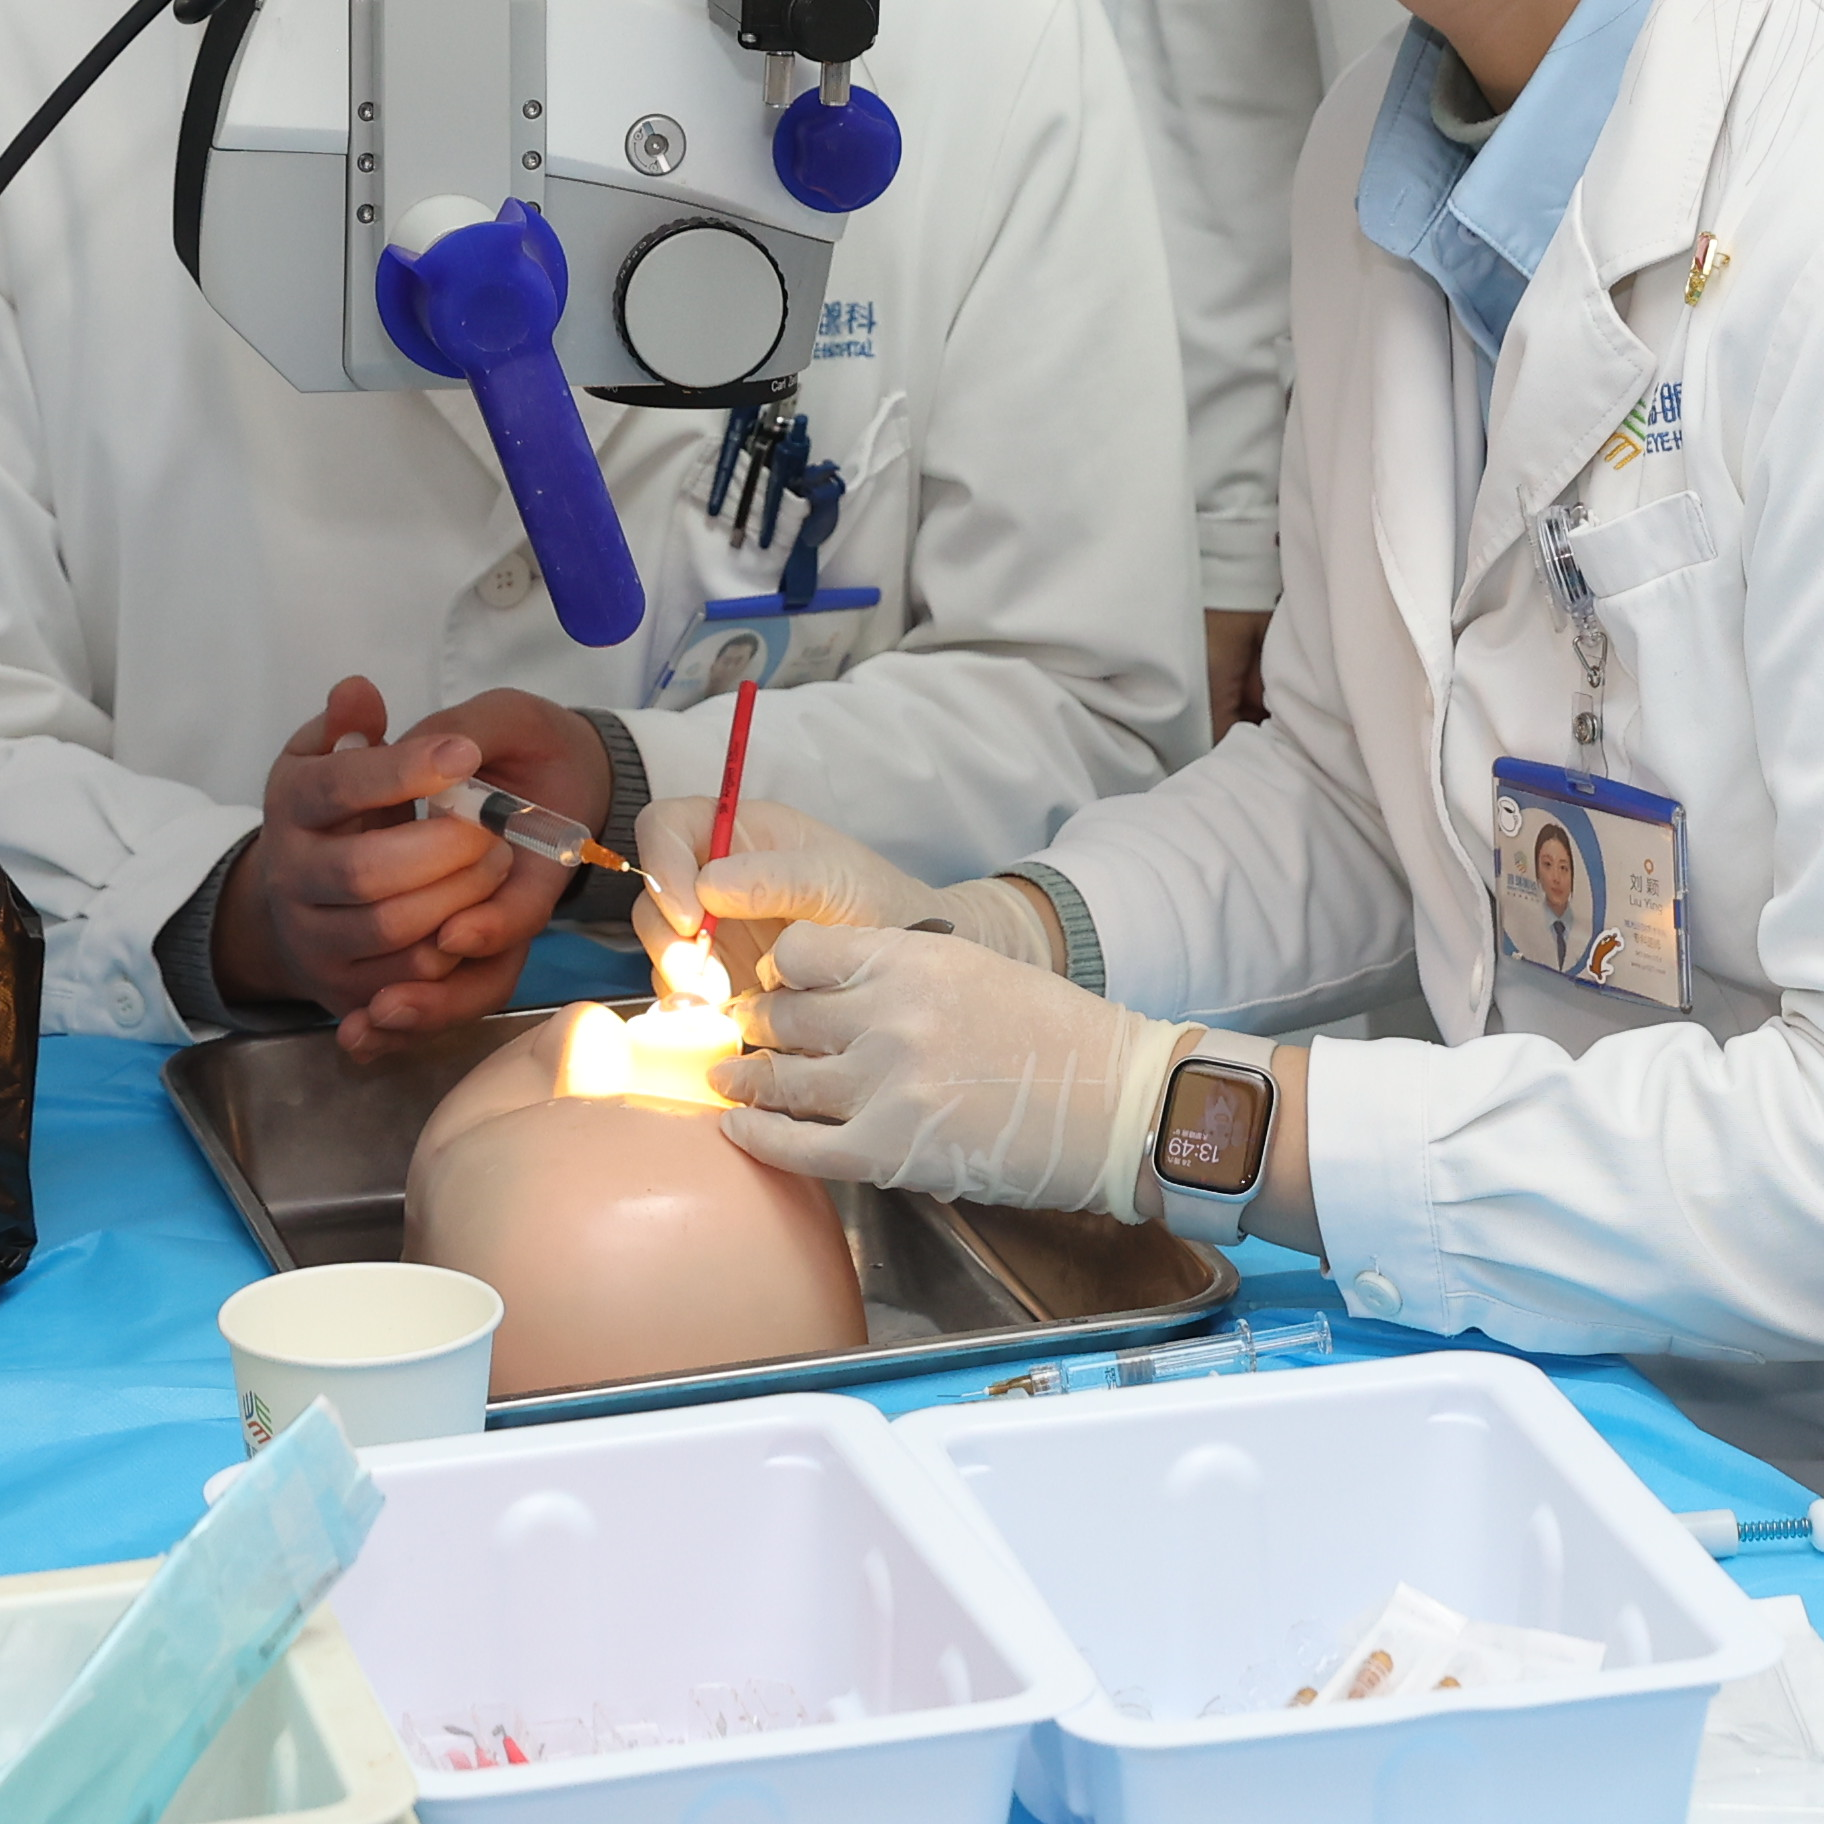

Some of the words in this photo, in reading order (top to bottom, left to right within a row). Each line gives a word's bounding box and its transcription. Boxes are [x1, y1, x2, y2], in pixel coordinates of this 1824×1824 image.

[1646, 430, 1673, 454] EYE
[1629, 894, 1643, 909] Liu
[1643, 897, 1664, 915] Ying
[1168, 1137, 1220, 1164] 13:49
